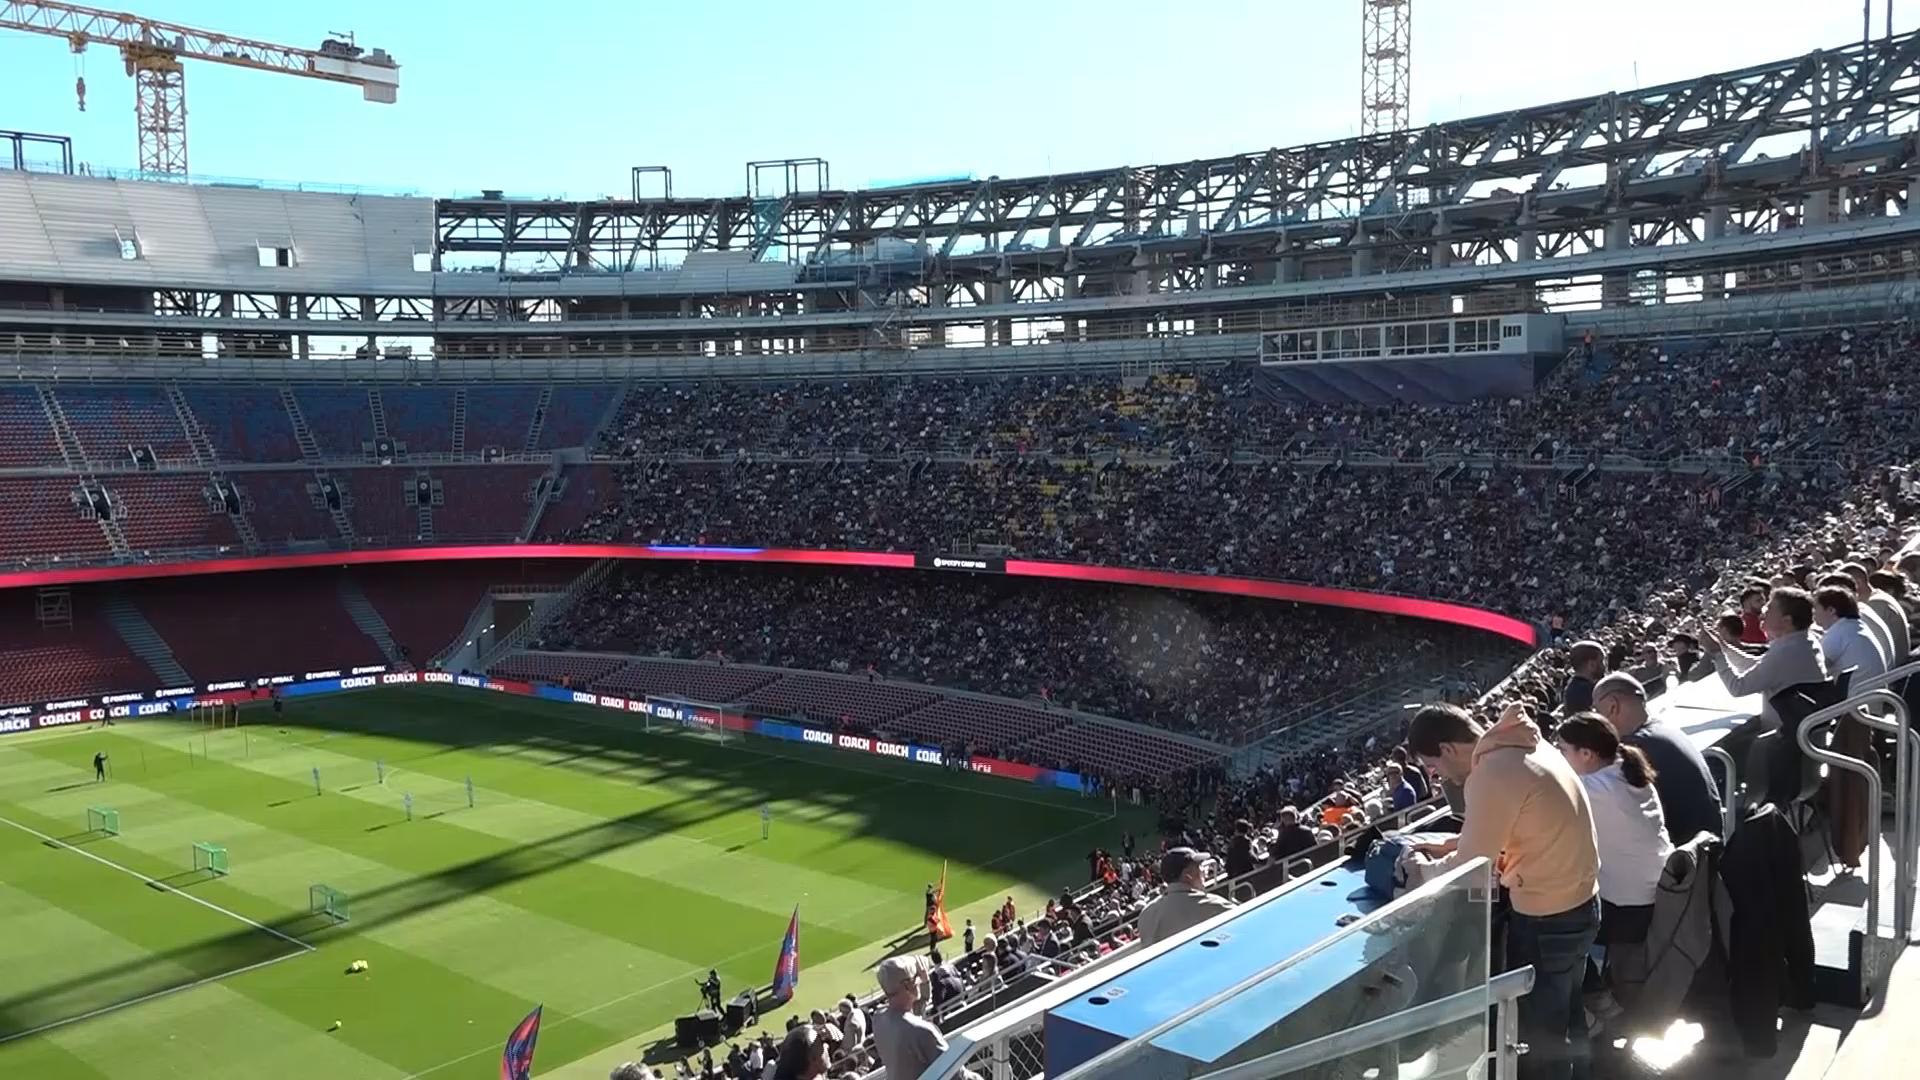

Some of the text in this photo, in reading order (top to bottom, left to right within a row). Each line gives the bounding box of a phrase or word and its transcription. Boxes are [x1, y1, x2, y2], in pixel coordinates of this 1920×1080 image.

[941, 559, 960, 567] SPOTIFY
[961, 560, 975, 568] CAMP
[341, 675, 376, 688] COACH
[383, 672, 417, 683] COACH
[424, 672, 453, 683] COACH
[458, 676, 480, 687] COACH
[163, 687, 195, 696] FOOTBALL
[110, 693, 144, 703] FOOTBALL
[573, 691, 596, 705] COACH
[601, 696, 624, 709] COACH
[54, 700, 89, 710] FOOTBALL
[39, 711, 81, 727] COACH
[803, 729, 833, 745] COACH
[839, 735, 870, 751] COACH
[876, 741, 909, 758] COACH
